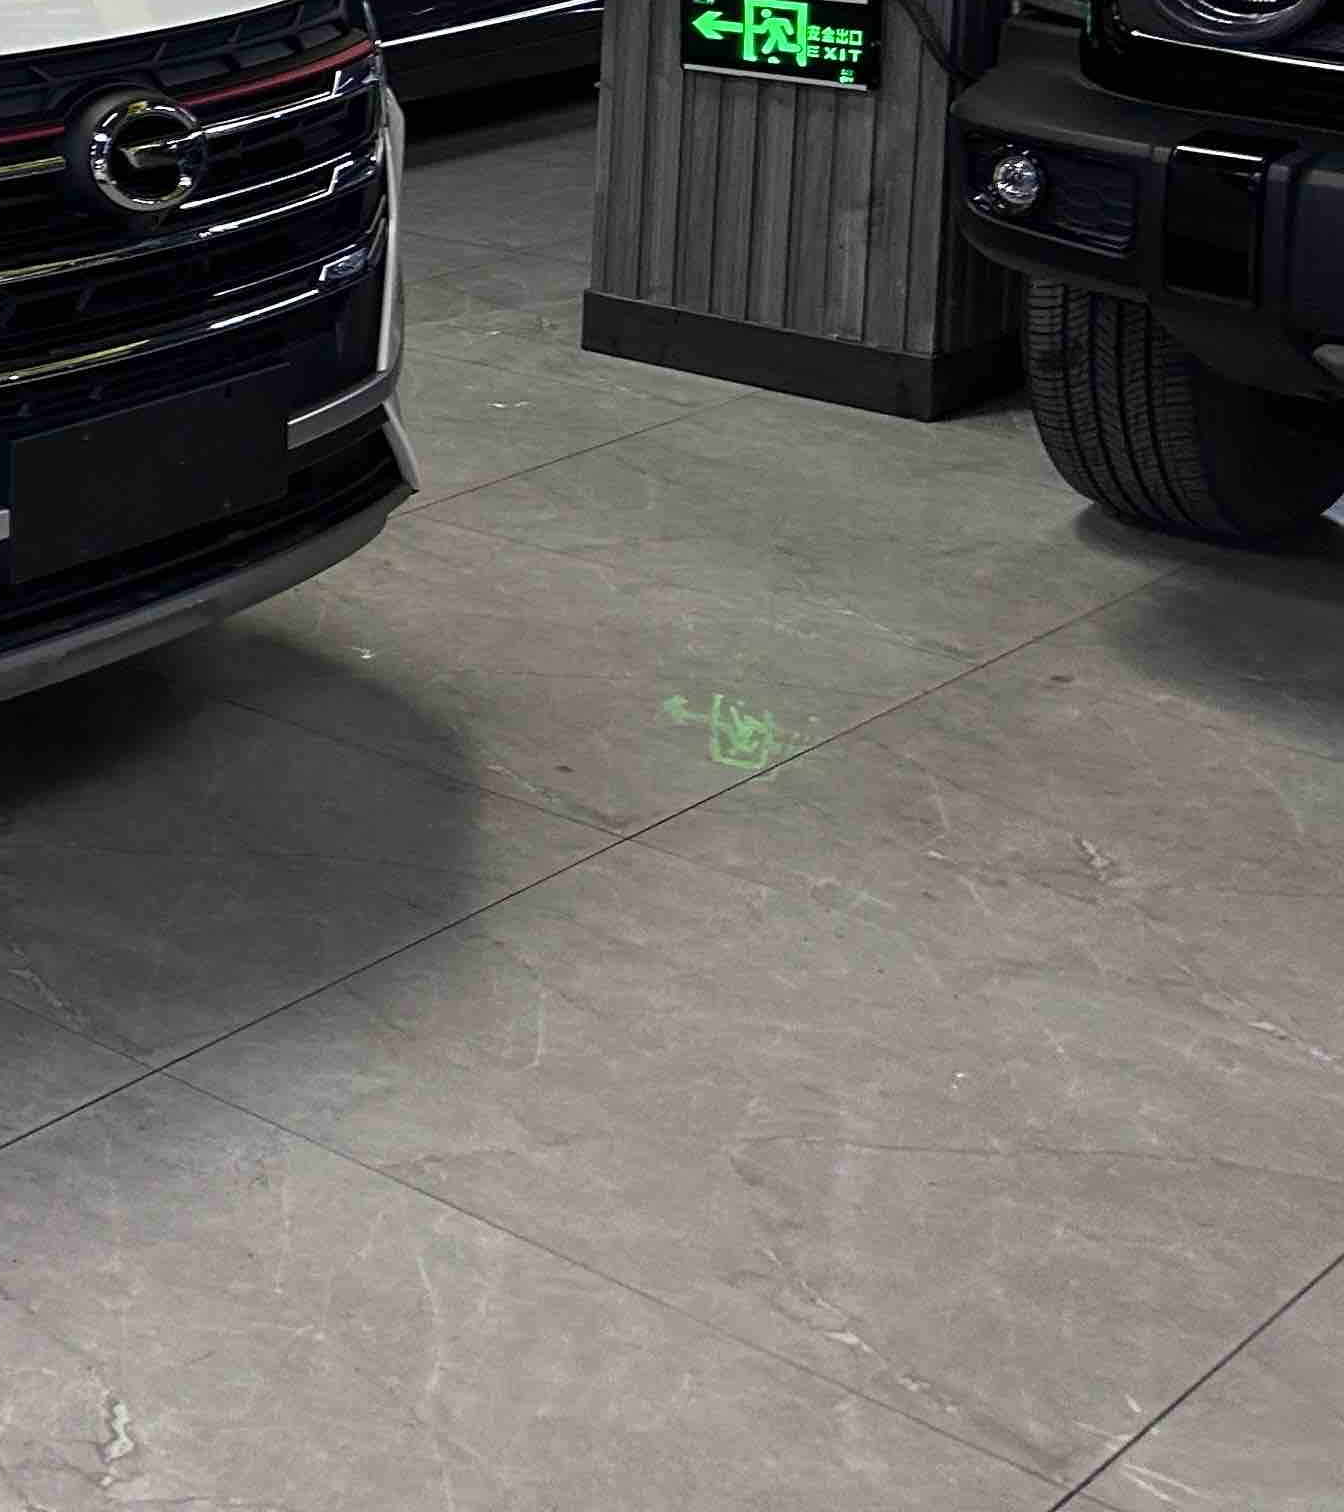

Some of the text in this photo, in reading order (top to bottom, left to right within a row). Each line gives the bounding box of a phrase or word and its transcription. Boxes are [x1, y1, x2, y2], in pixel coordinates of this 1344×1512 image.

[807, 25, 864, 47] 安全出口
[807, 45, 863, 63] EXIT
